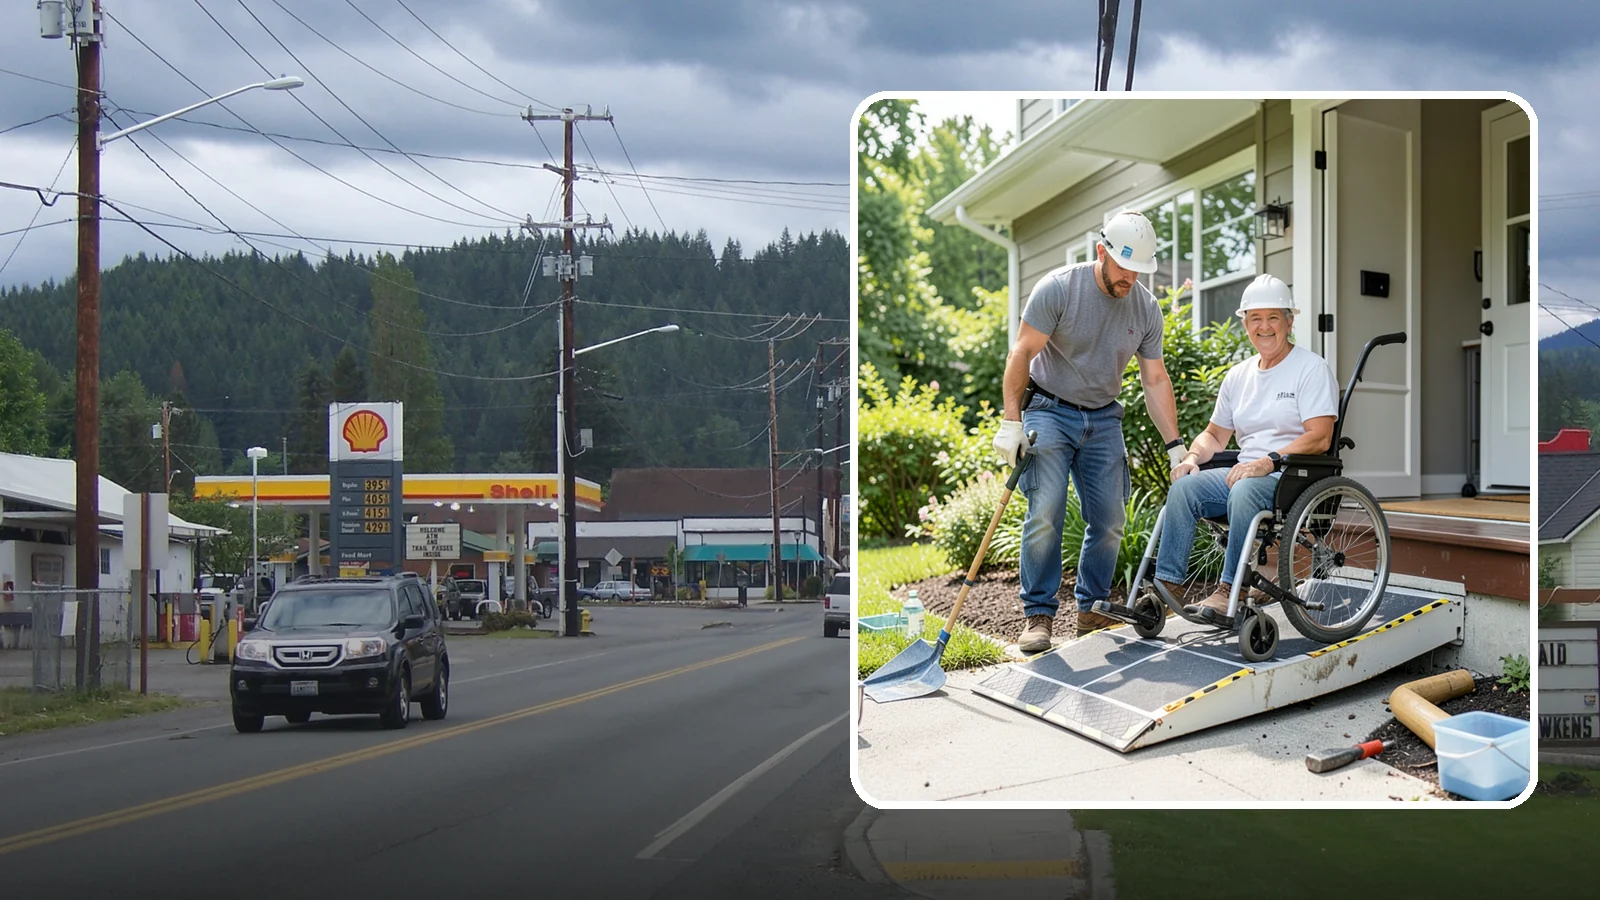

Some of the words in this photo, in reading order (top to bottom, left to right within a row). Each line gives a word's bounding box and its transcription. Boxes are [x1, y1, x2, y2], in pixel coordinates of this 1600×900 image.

[366, 480, 383, 490] 395
[490, 484, 547, 499] Shell
[366, 494, 383, 504] 405
[365, 508, 383, 518] 415
[365, 522, 383, 532] 429
